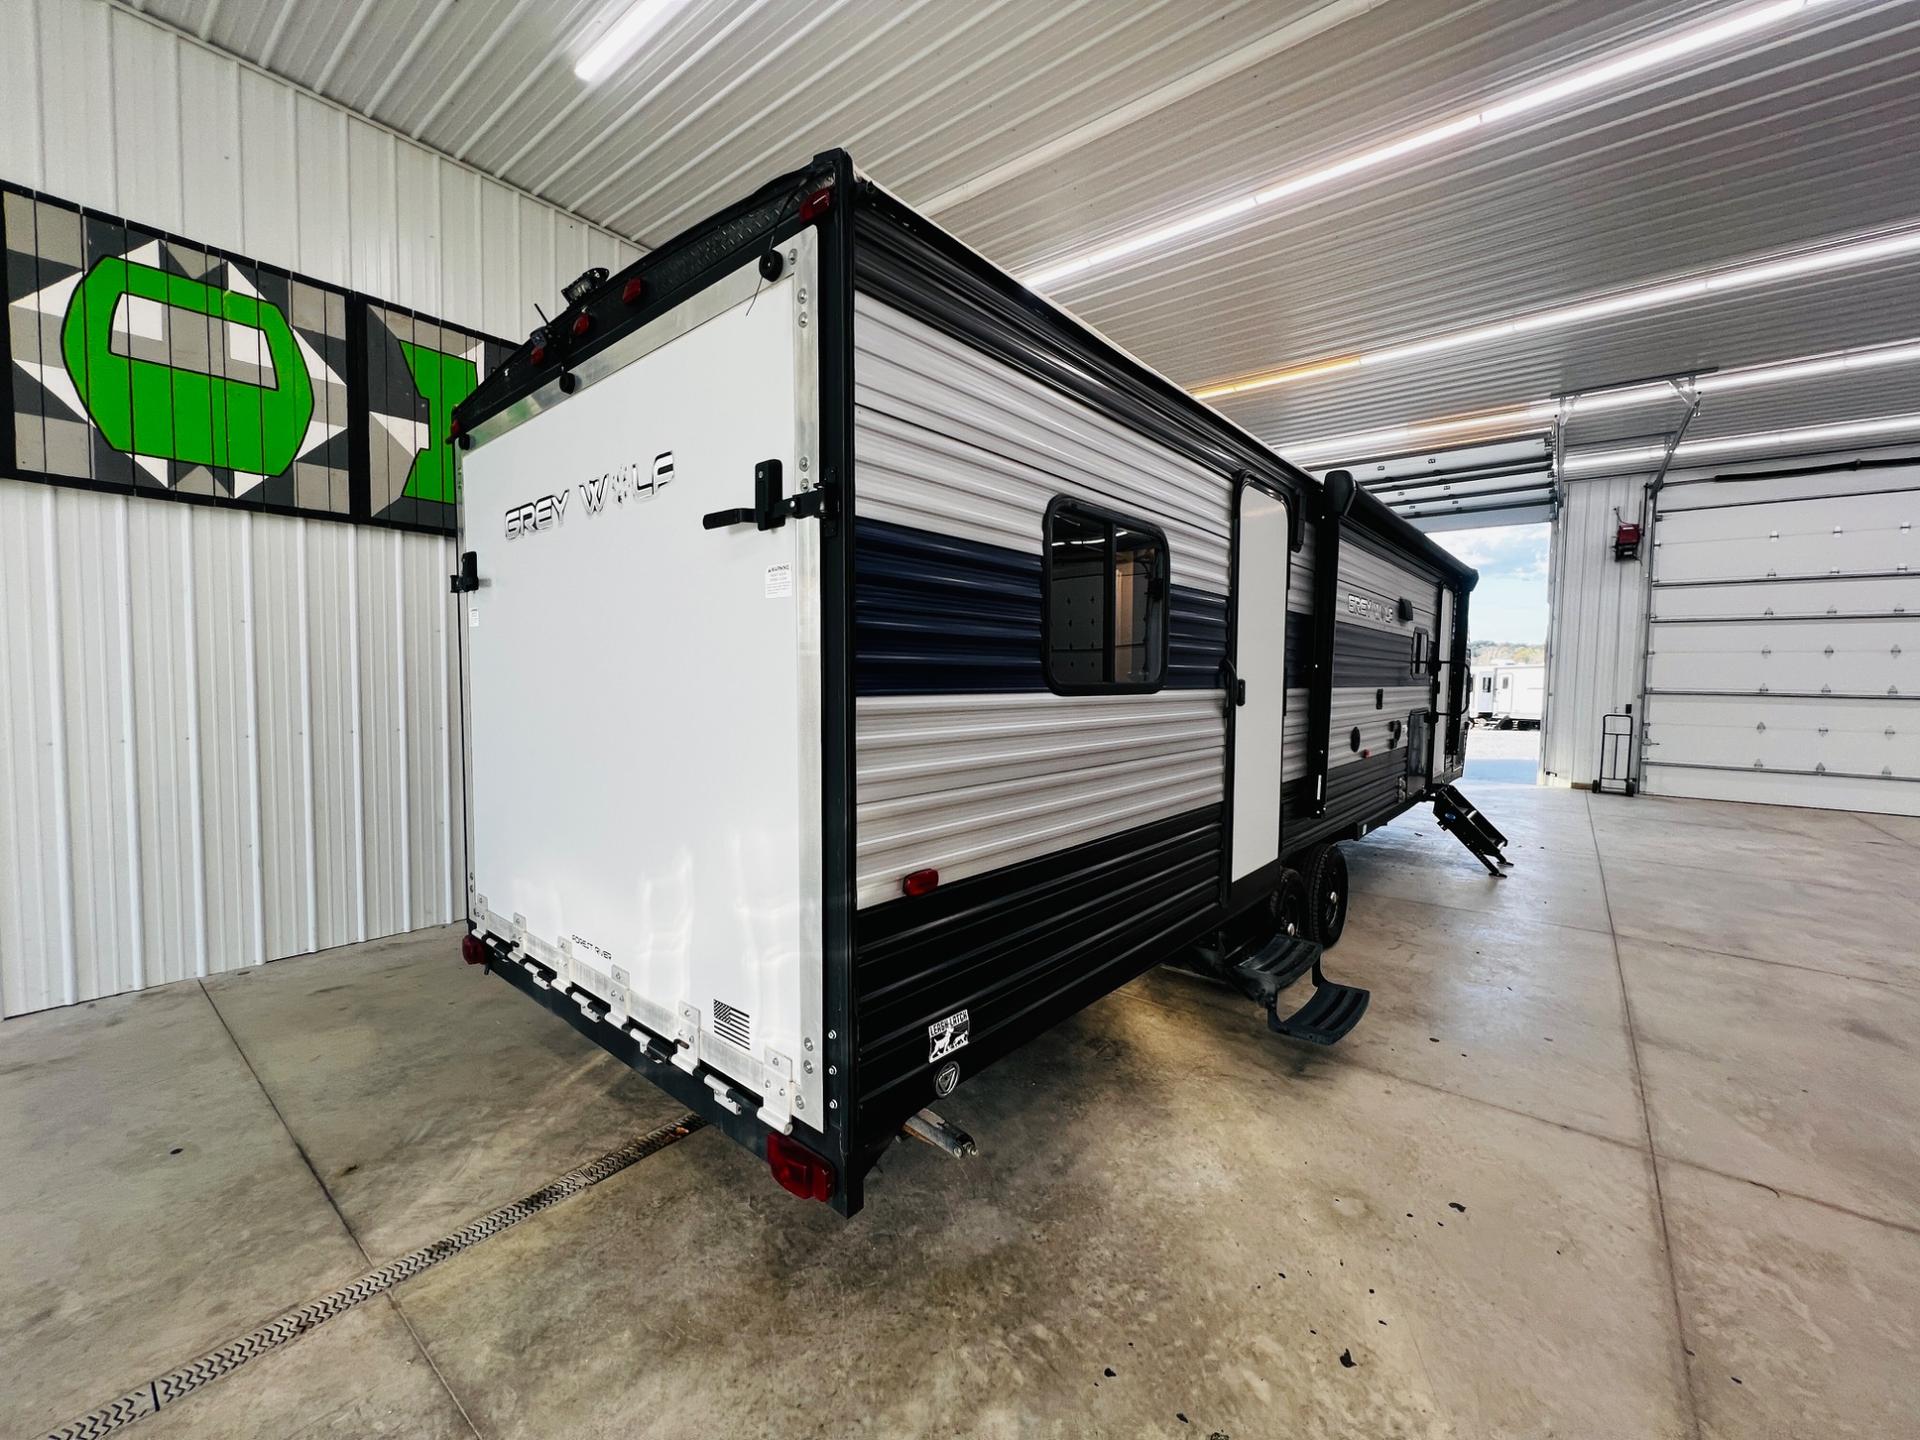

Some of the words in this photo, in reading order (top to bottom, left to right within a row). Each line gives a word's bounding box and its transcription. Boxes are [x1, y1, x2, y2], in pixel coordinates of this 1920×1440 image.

[505, 489, 570, 540] GREY
[929, 1018, 949, 1036] LEASH
[949, 1011, 968, 1028] LATCH
